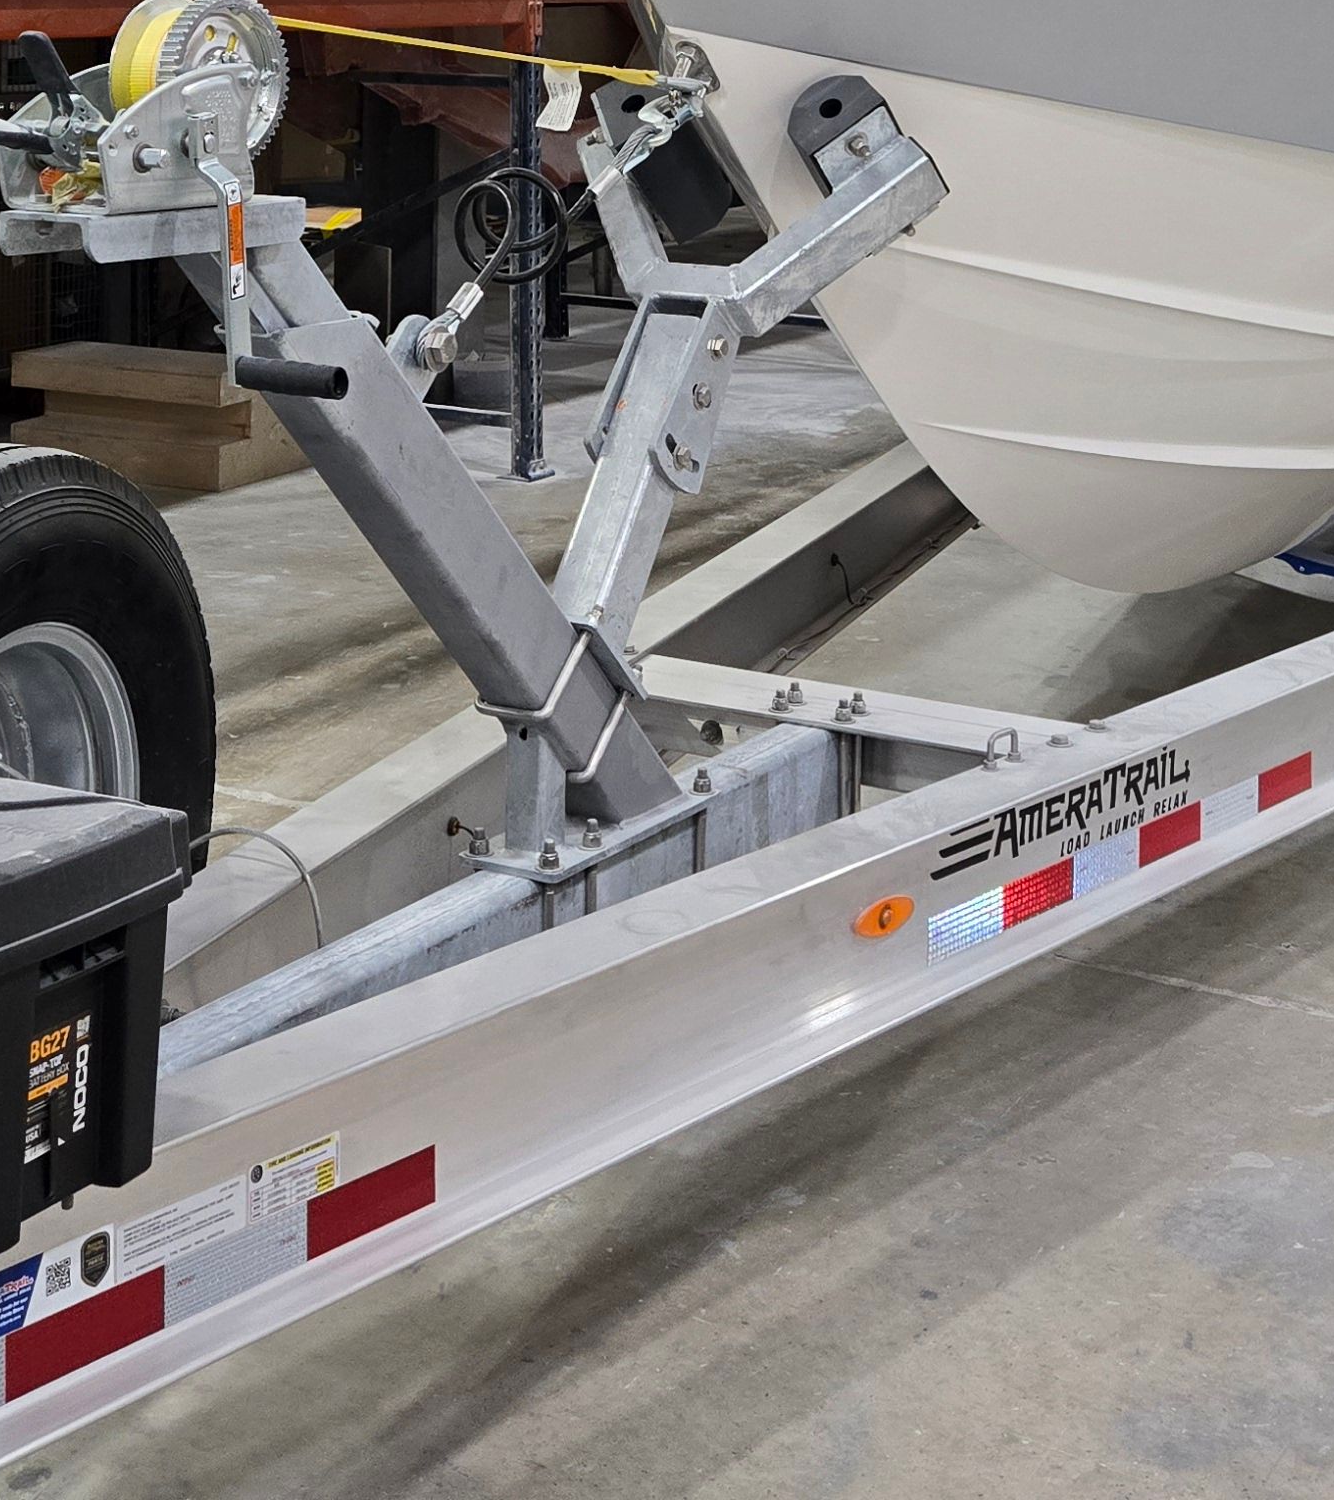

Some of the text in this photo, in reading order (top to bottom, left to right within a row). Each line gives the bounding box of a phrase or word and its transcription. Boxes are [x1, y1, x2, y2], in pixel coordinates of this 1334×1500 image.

[1060, 790, 1189, 858] LOAD LAUNCH RELAX
[29, 1024, 72, 1064] BG27
[72, 1043, 91, 1133] NOCO
